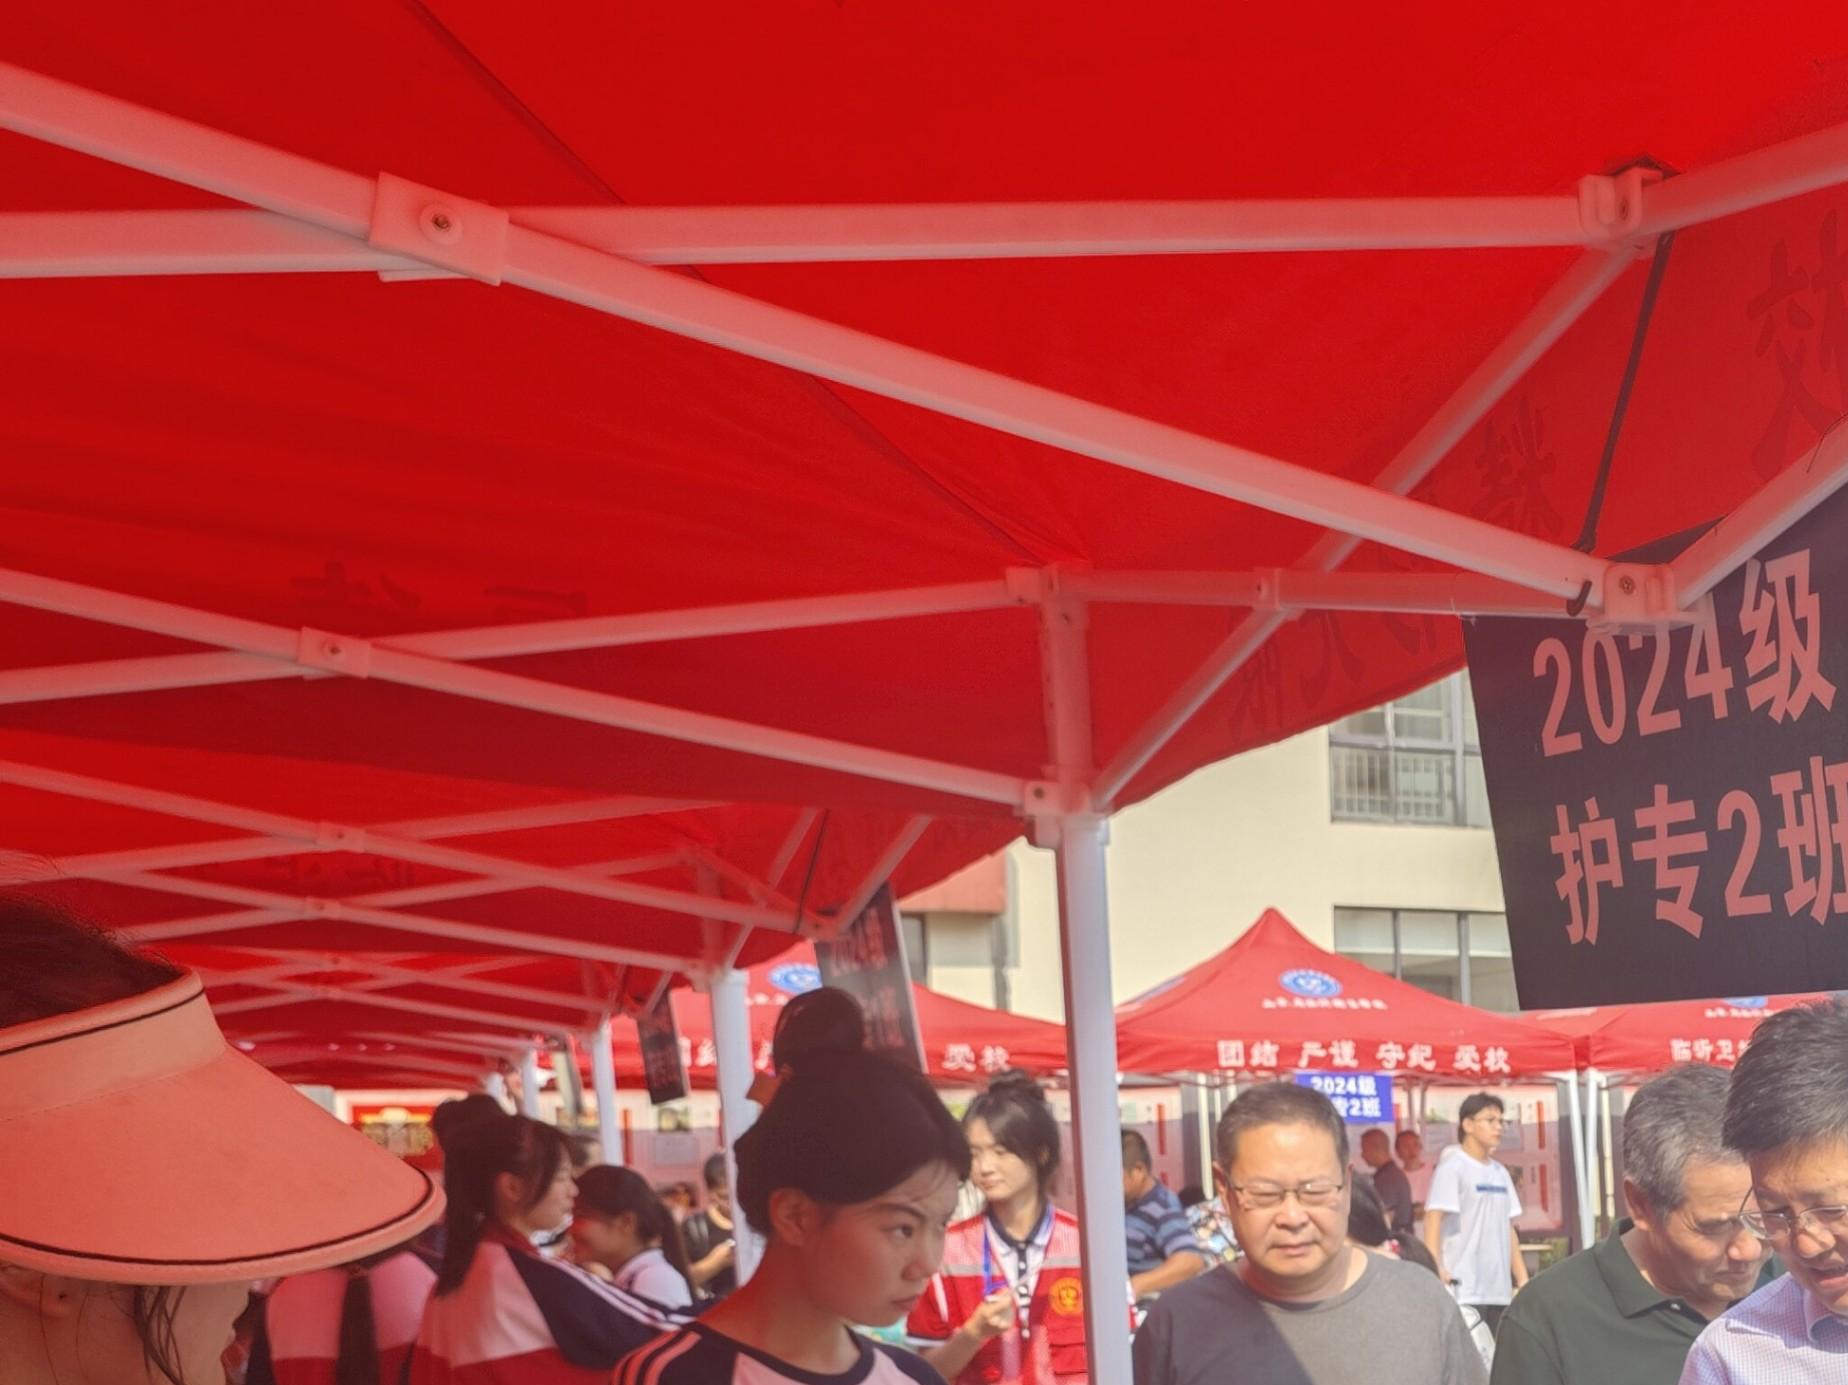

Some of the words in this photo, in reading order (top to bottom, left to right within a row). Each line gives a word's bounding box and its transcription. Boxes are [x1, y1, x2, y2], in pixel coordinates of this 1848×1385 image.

[1532, 549, 1838, 757] 2024级
[1216, 1039, 1280, 1068] 团结
[1298, 1040, 1359, 1069] 严谨
[1376, 1041, 1437, 1072] 守纪
[1453, 1044, 1511, 1073] 爱校
[1670, 1038, 1747, 1062] 临沂卫
[1311, 1075, 1377, 1097] 2024级
